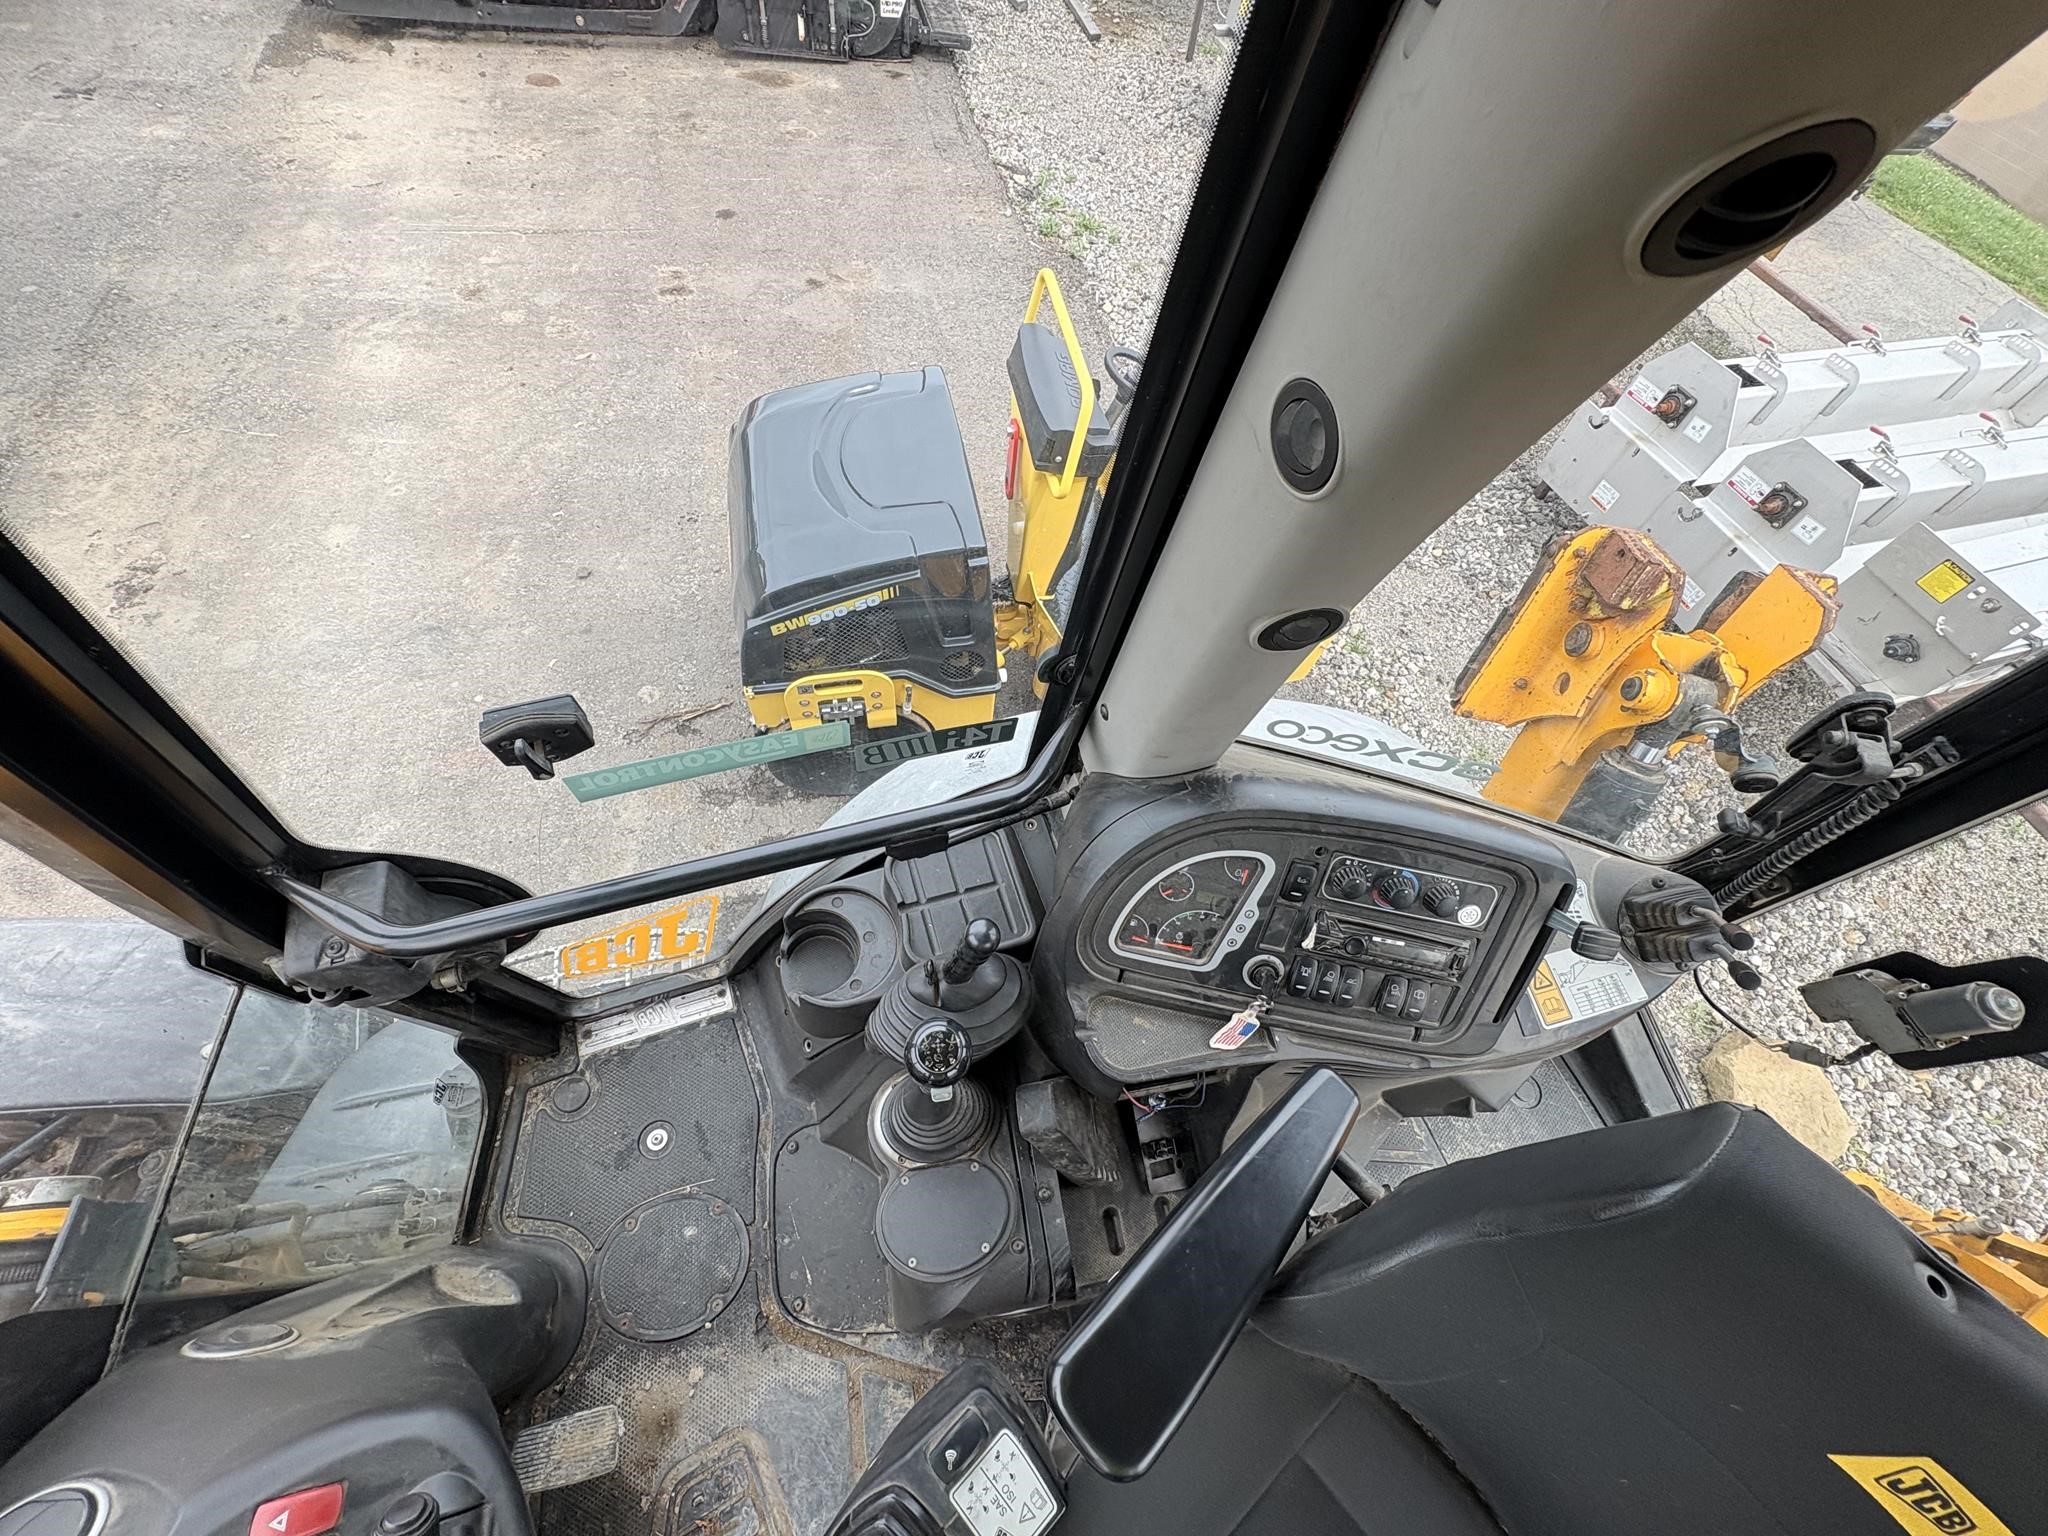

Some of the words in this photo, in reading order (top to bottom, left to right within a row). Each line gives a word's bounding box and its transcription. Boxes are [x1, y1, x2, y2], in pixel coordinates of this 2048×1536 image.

[990, 1494, 1008, 1517] SAE
[1001, 1484, 1017, 1504] ISO
[1885, 1475, 1968, 1531] JCB
